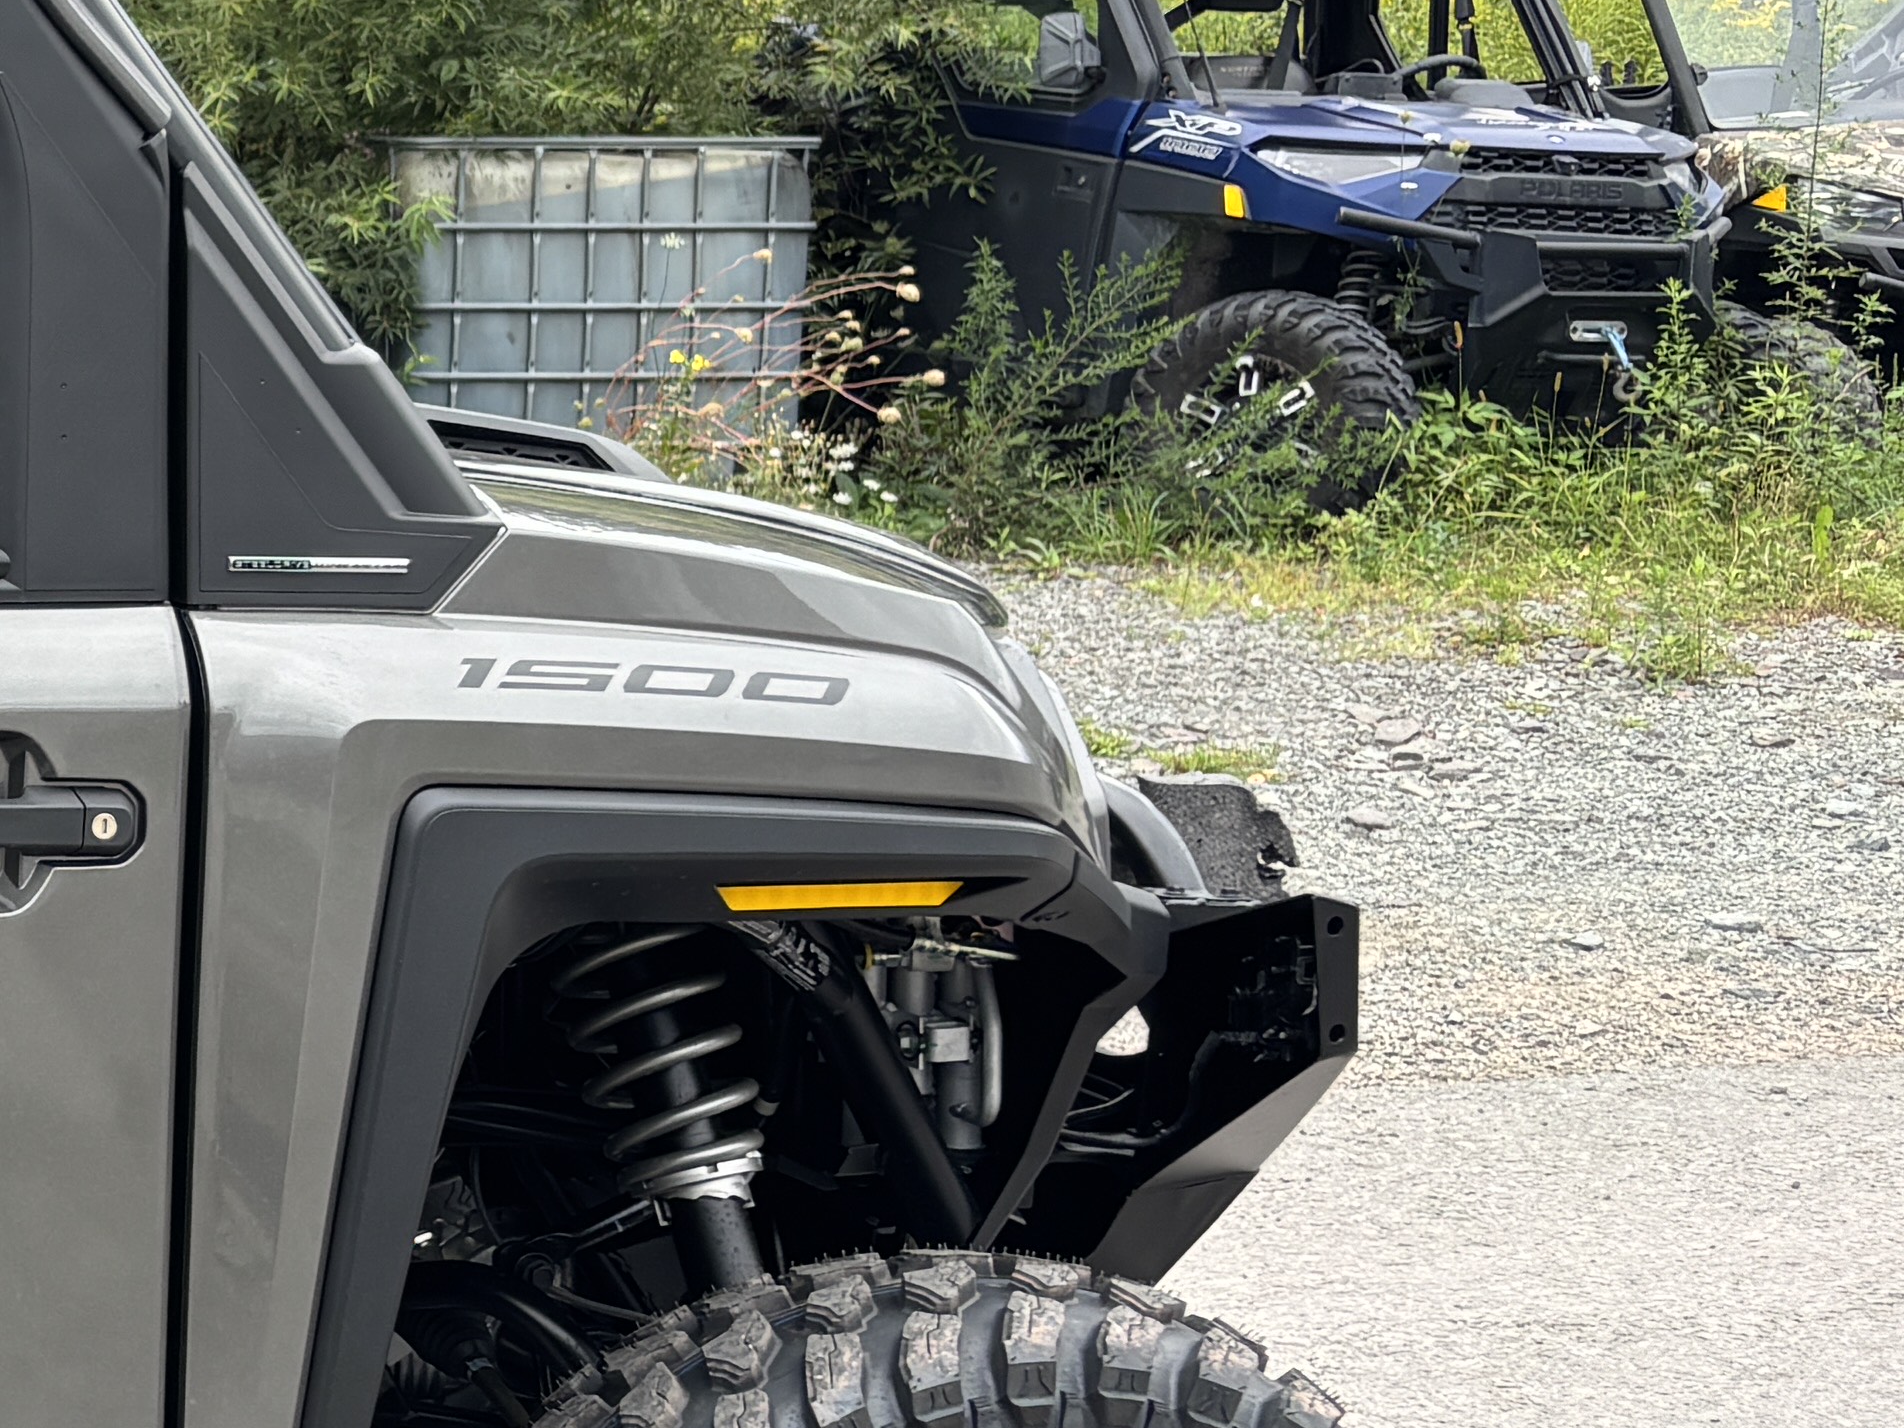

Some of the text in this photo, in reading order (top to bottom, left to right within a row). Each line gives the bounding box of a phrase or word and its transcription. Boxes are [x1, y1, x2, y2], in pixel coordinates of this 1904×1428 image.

[1145, 108, 1243, 136] XP
[1519, 179, 1623, 201] POLARIS
[456, 657, 850, 705] 1500
